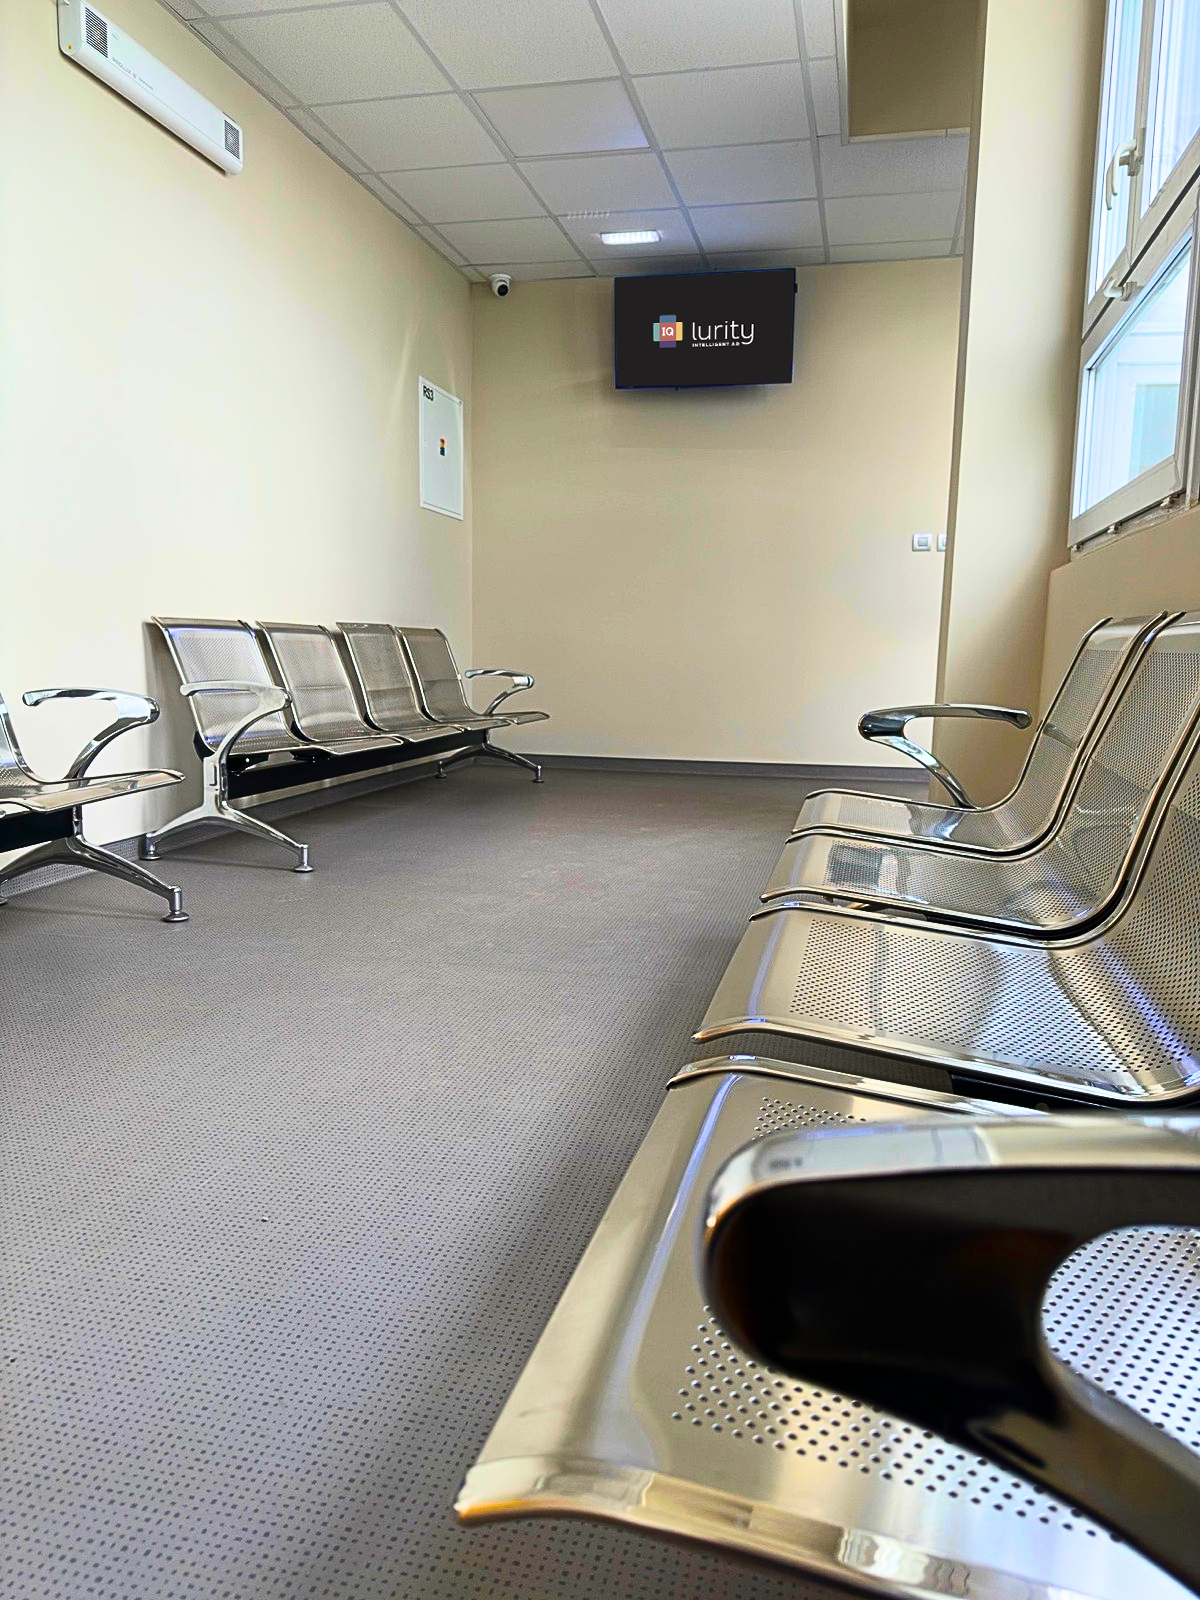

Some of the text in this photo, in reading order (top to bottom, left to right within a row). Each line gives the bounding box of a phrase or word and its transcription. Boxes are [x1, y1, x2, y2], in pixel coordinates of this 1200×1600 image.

[662, 326, 674, 336] IQ
[692, 320, 754, 345] lurity
[423, 385, 434, 401] RS3
